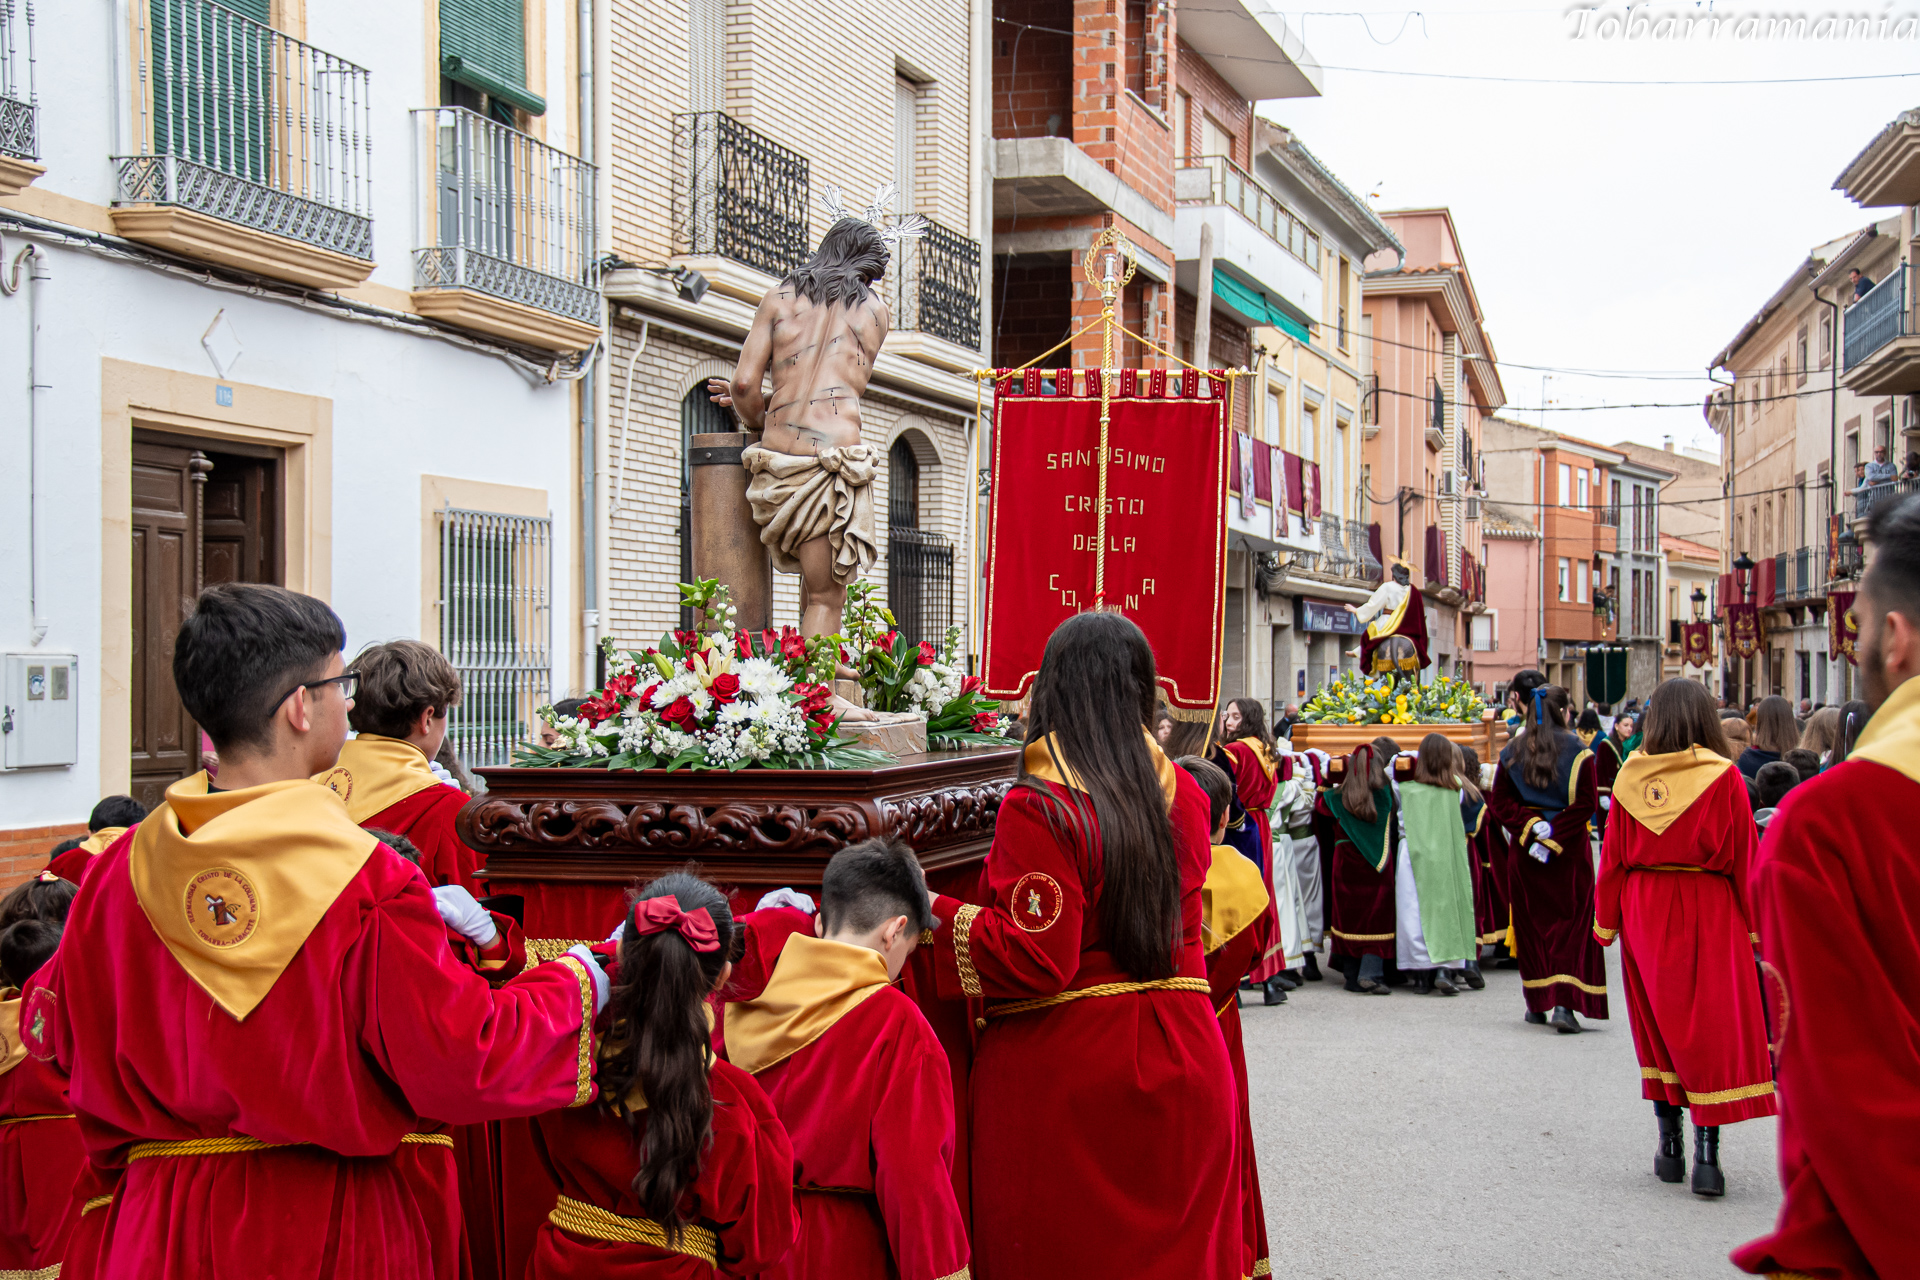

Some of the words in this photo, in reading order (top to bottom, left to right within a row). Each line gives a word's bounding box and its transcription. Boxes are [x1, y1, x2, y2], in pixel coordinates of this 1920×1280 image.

[1065, 495, 1144, 515] CRISTO
[1073, 534, 1099, 552] DE
[1110, 535, 1136, 553] LA
[197, 871, 220, 884] CRISTO
[234, 875, 243, 885] LA
[242, 884, 257, 913] COLUMNA
